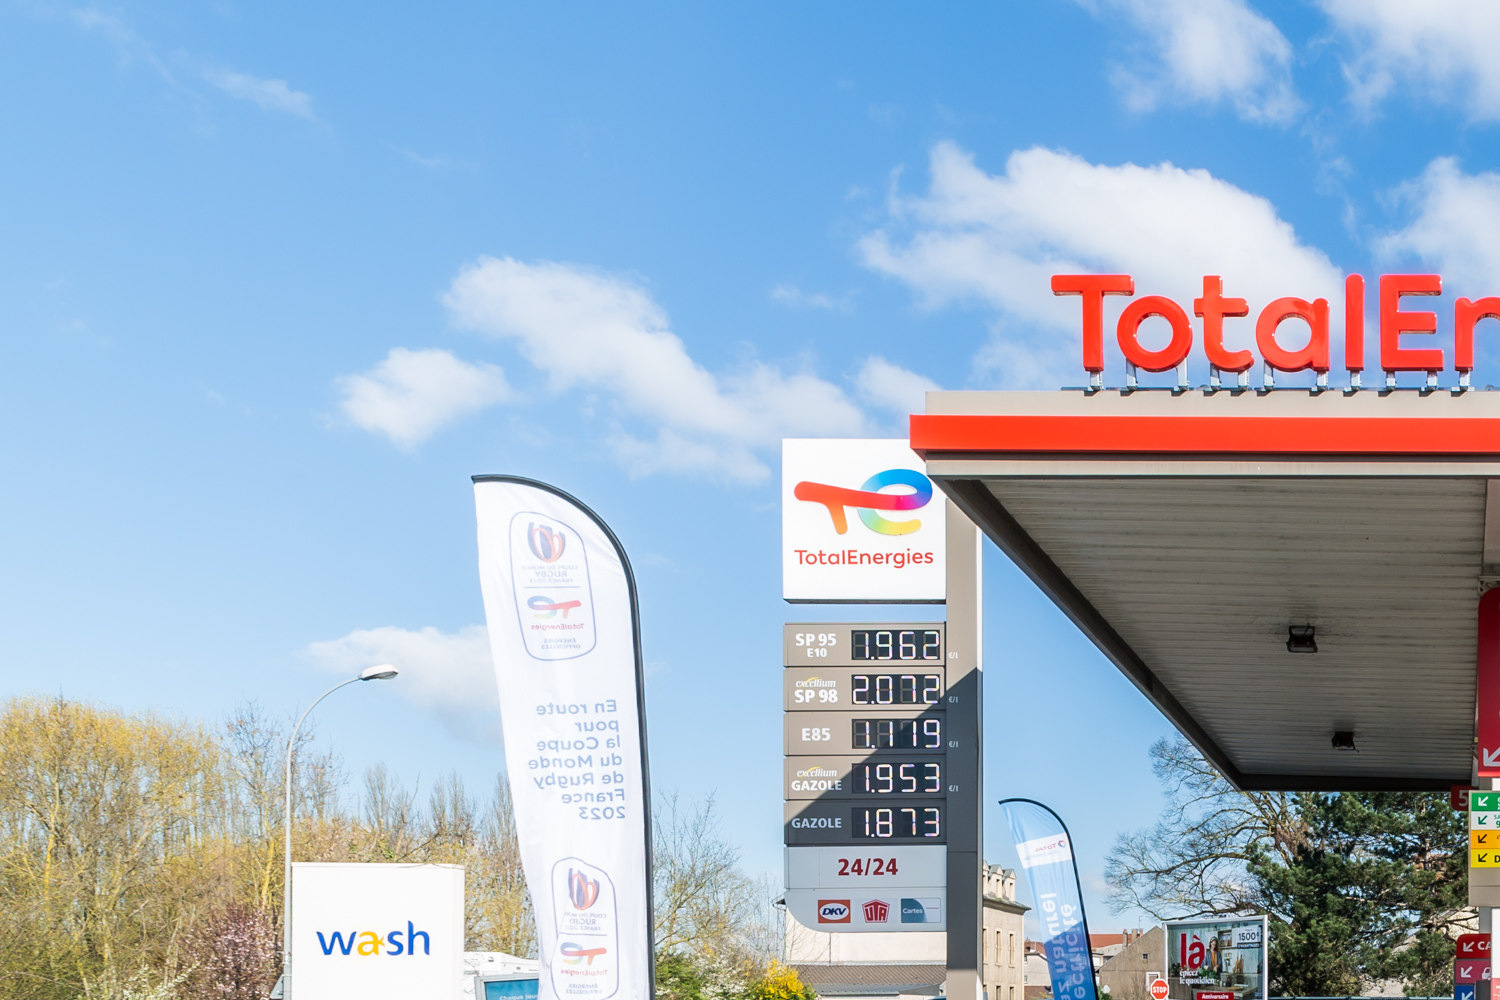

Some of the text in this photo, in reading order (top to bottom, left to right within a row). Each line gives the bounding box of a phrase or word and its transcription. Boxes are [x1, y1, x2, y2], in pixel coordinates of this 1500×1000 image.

[794, 548, 934, 568] TotalEnergies
[795, 633, 837, 646] SP 95
[864, 631, 939, 660] 1.962
[806, 648, 828, 658] E10
[795, 678, 837, 688] excellium
[852, 675, 939, 704] 2.072
[794, 689, 838, 703] SP 98
[801, 728, 831, 741] E85
[865, 719, 940, 748] 1.119
[796, 768, 837, 777] excellium
[864, 763, 940, 793] 1.953
[791, 780, 842, 791] GAZOLE
[791, 818, 842, 829] GAZOLE
[864, 808, 940, 837] 1.873
[838, 858, 898, 876] 24/24
[822, 907, 847, 916] DKV
[862, 900, 890, 922] UTA
[316, 920, 430, 956] wash
[1180, 933, 1205, 969] là
